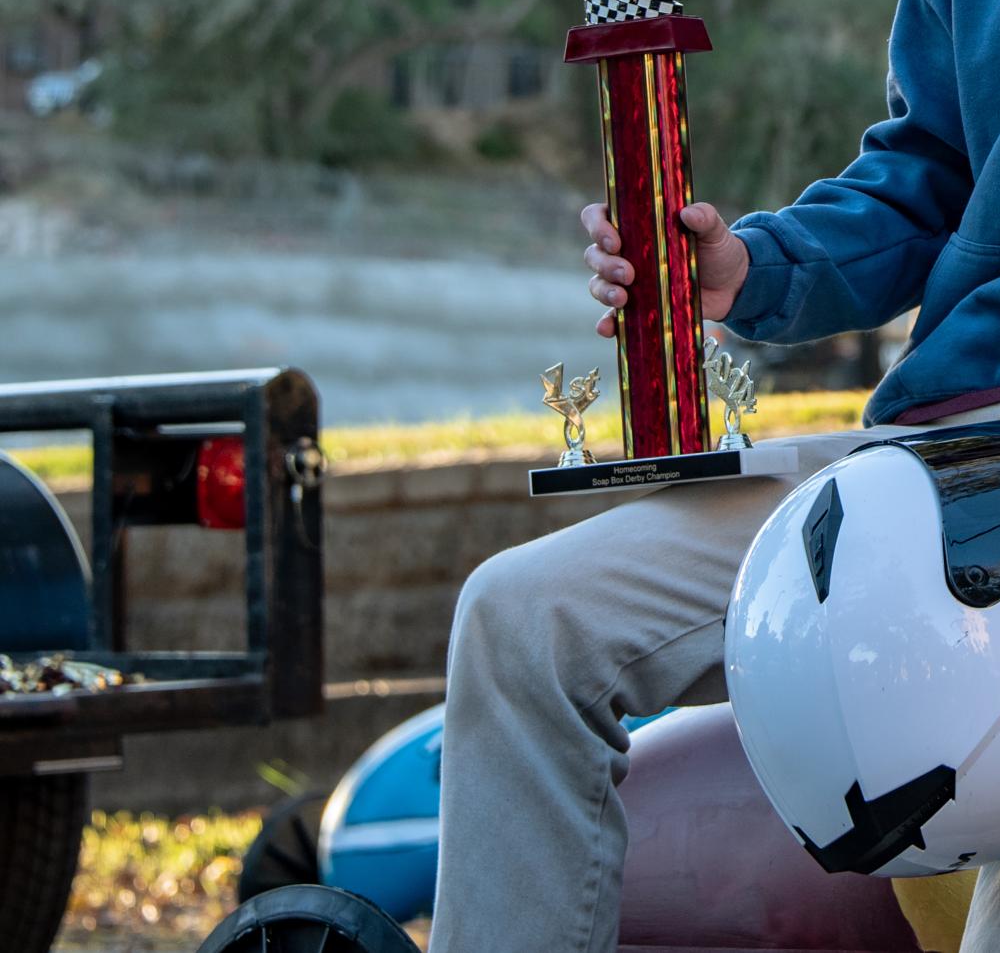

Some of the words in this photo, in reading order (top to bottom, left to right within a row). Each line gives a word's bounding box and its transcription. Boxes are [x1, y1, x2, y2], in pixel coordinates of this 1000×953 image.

[613, 463, 657, 474] Homecoming
[592, 477, 610, 486] Soap
[611, 476, 624, 485] Box
[625, 474, 645, 483] Derby
[646, 471, 680, 481] Champion
